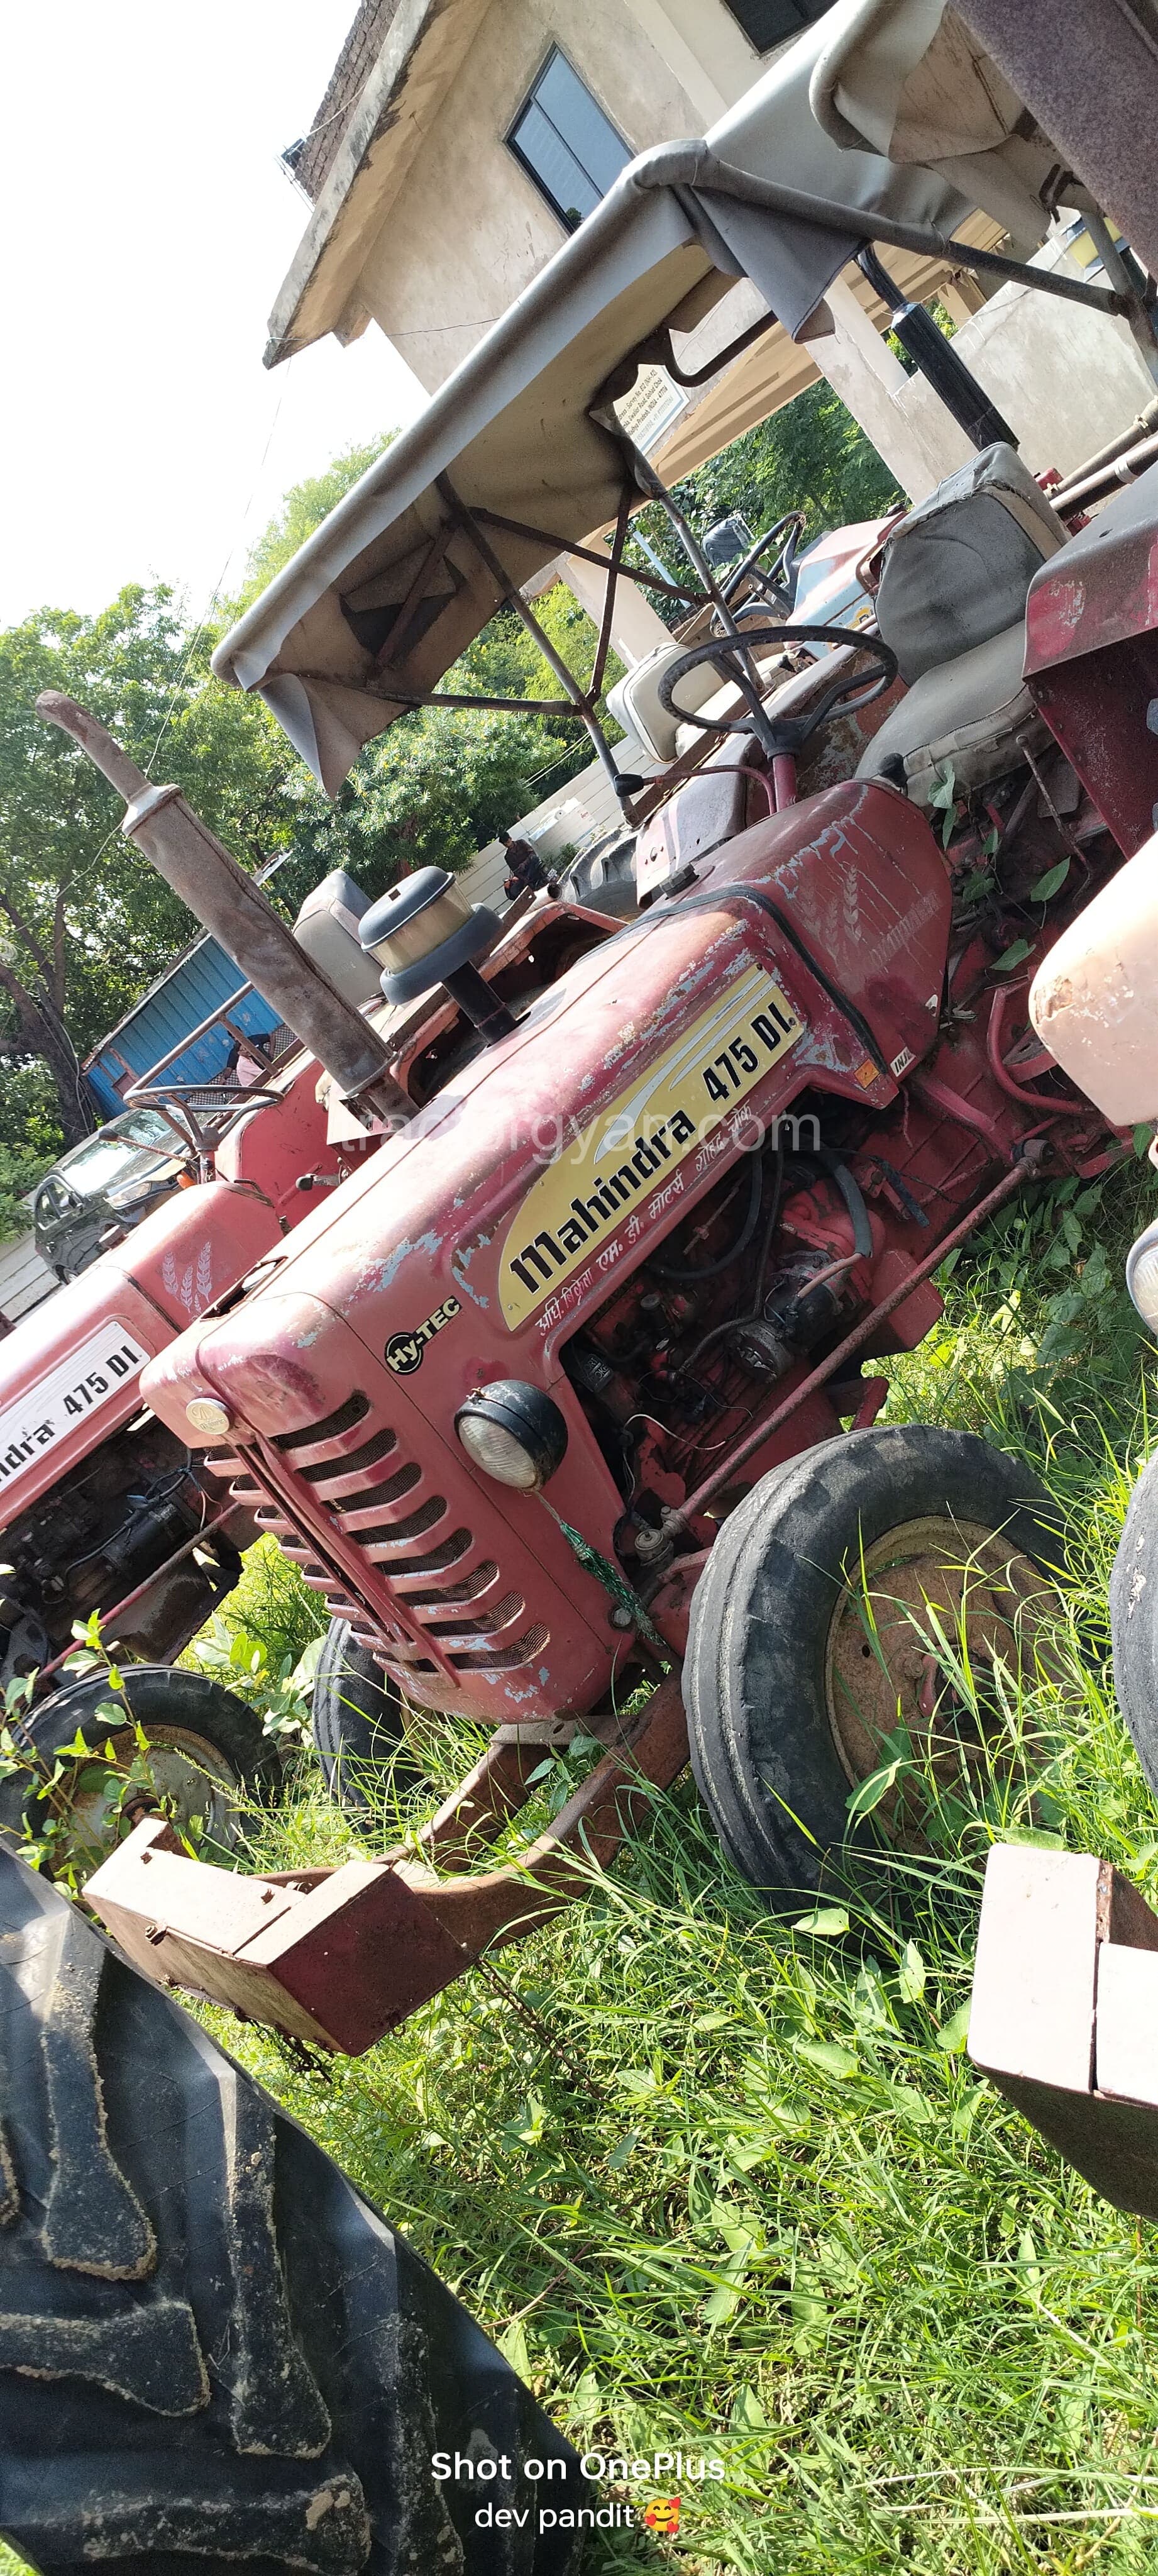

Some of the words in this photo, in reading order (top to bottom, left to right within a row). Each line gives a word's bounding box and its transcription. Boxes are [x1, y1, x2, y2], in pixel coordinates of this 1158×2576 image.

[509, 1109, 696, 1294] Mahindra
[702, 1036, 759, 1103] 475
[750, 1001, 792, 1052] DI
[387, 1298, 460, 1372] Hy-TEC
[0, 1424, 55, 1482] ndra
[63, 1372, 109, 1415] 475
[106, 1345, 140, 1377] DI
